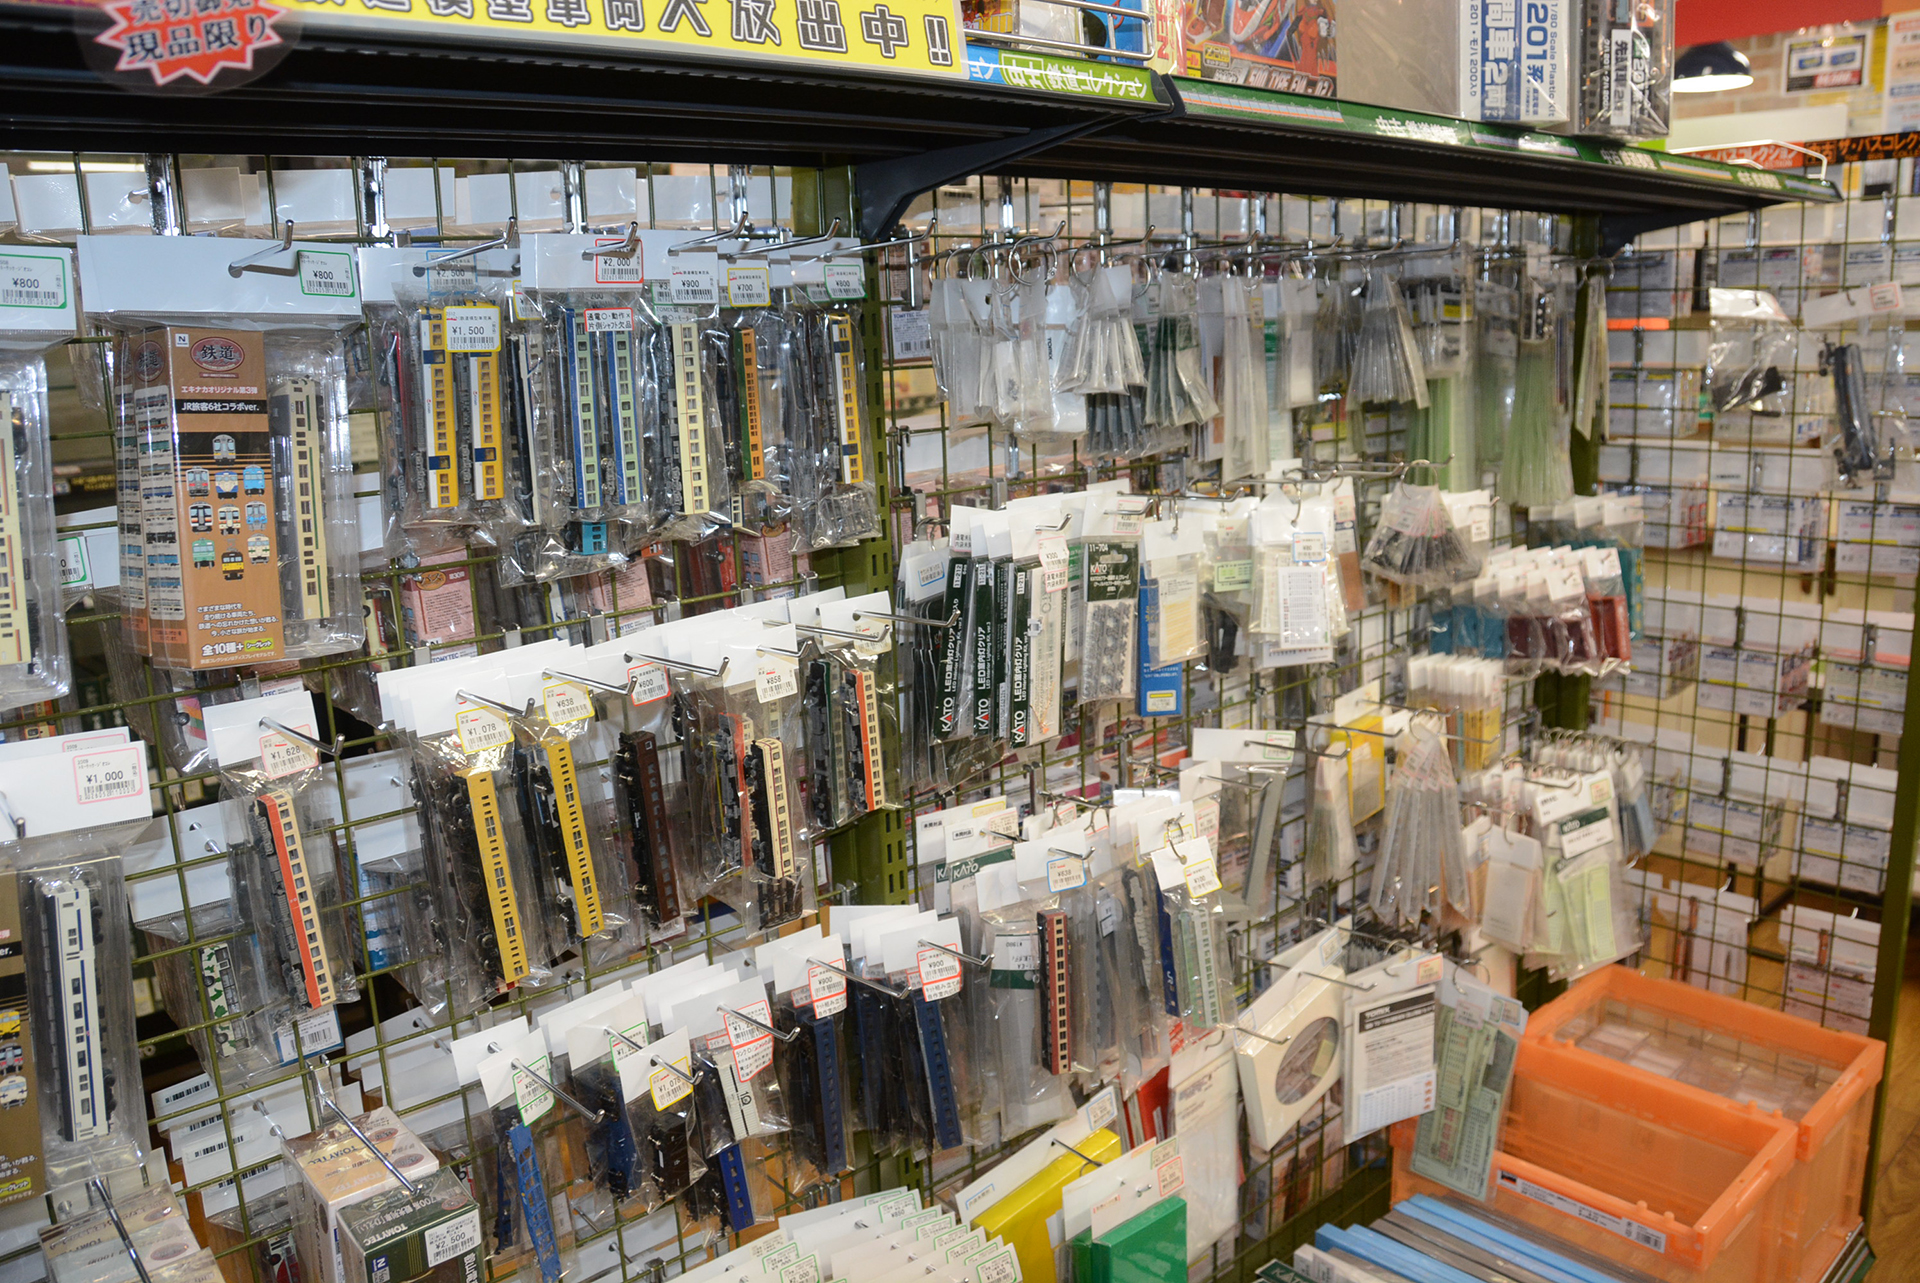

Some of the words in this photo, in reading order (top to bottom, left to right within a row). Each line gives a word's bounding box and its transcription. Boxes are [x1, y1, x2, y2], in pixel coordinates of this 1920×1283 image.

[123, 15, 266, 63] 現品限り
[1549, 31, 1557, 60] Scale
[1549, 63, 1557, 98] Plastic
[12, 277, 40, 289] ¥800
[312, 270, 334, 280] ¥800
[681, 279, 700, 288] ¥900
[736, 283, 754, 292] ¥700
[201, 345, 235, 360] 鉄道
[1090, 562, 1108, 574] KATO
[978, 626, 986, 690] LED室内灯クリア
[1014, 636, 1023, 702] LED室内灯クリア
[939, 697, 954, 732] KATO
[976, 697, 989, 730] KATO
[1014, 709, 1026, 743] KATO
[953, 862, 979, 879] KATO
[928, 960, 945, 969] ¥900
[818, 976, 833, 985] ¥900
[363, 1223, 409, 1246] TOMYTEC
